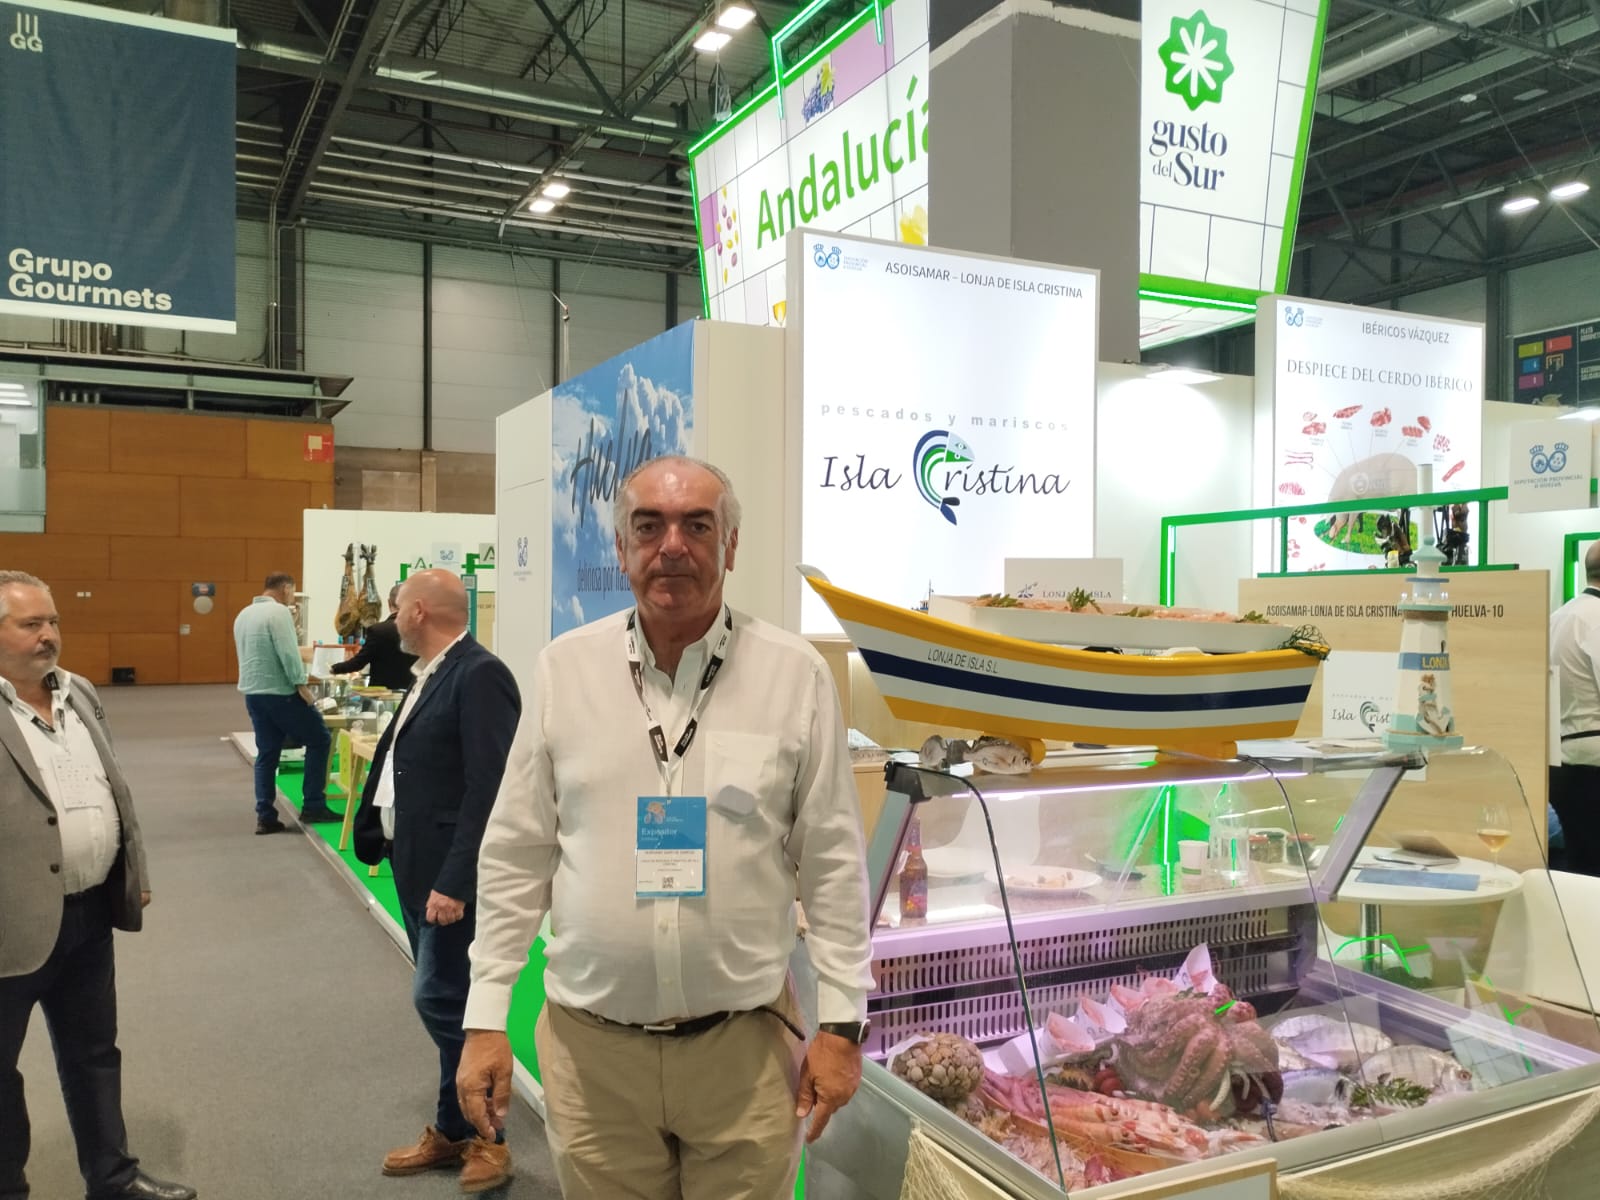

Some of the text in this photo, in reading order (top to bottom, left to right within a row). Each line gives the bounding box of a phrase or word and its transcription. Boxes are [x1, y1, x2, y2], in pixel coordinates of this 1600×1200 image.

[1149, 119, 1228, 157] gusto
[1152, 151, 1225, 191] del Sur
[8, 248, 113, 283] Grupo
[885, 261, 950, 281] ASOISAMAR
[960, 272, 995, 288] LONJA
[997, 277, 1011, 290] DE
[1013, 279, 1035, 293] ISLA
[1037, 282, 1083, 299] CRISTINA
[8, 273, 173, 311] Gourmets
[1362, 321, 1450, 345] IBÉRICOS VÁZQUEZ
[1287, 359, 1473, 393] DESPIECE DEL CERDO IBÉRICO
[821, 403, 1068, 432] pescados y mariscos
[820, 453, 902, 491] Isla
[1266, 605, 1332, 617] ASOISAMAR-LONJA
[1334, 605, 1344, 617] DE
[1346, 605, 1363, 617] ISLA
[928, 648, 953, 664] LONJA
[954, 654, 967, 668] DE
[967, 656, 985, 671] ISLA
[1331, 708, 1357, 721] Isla
